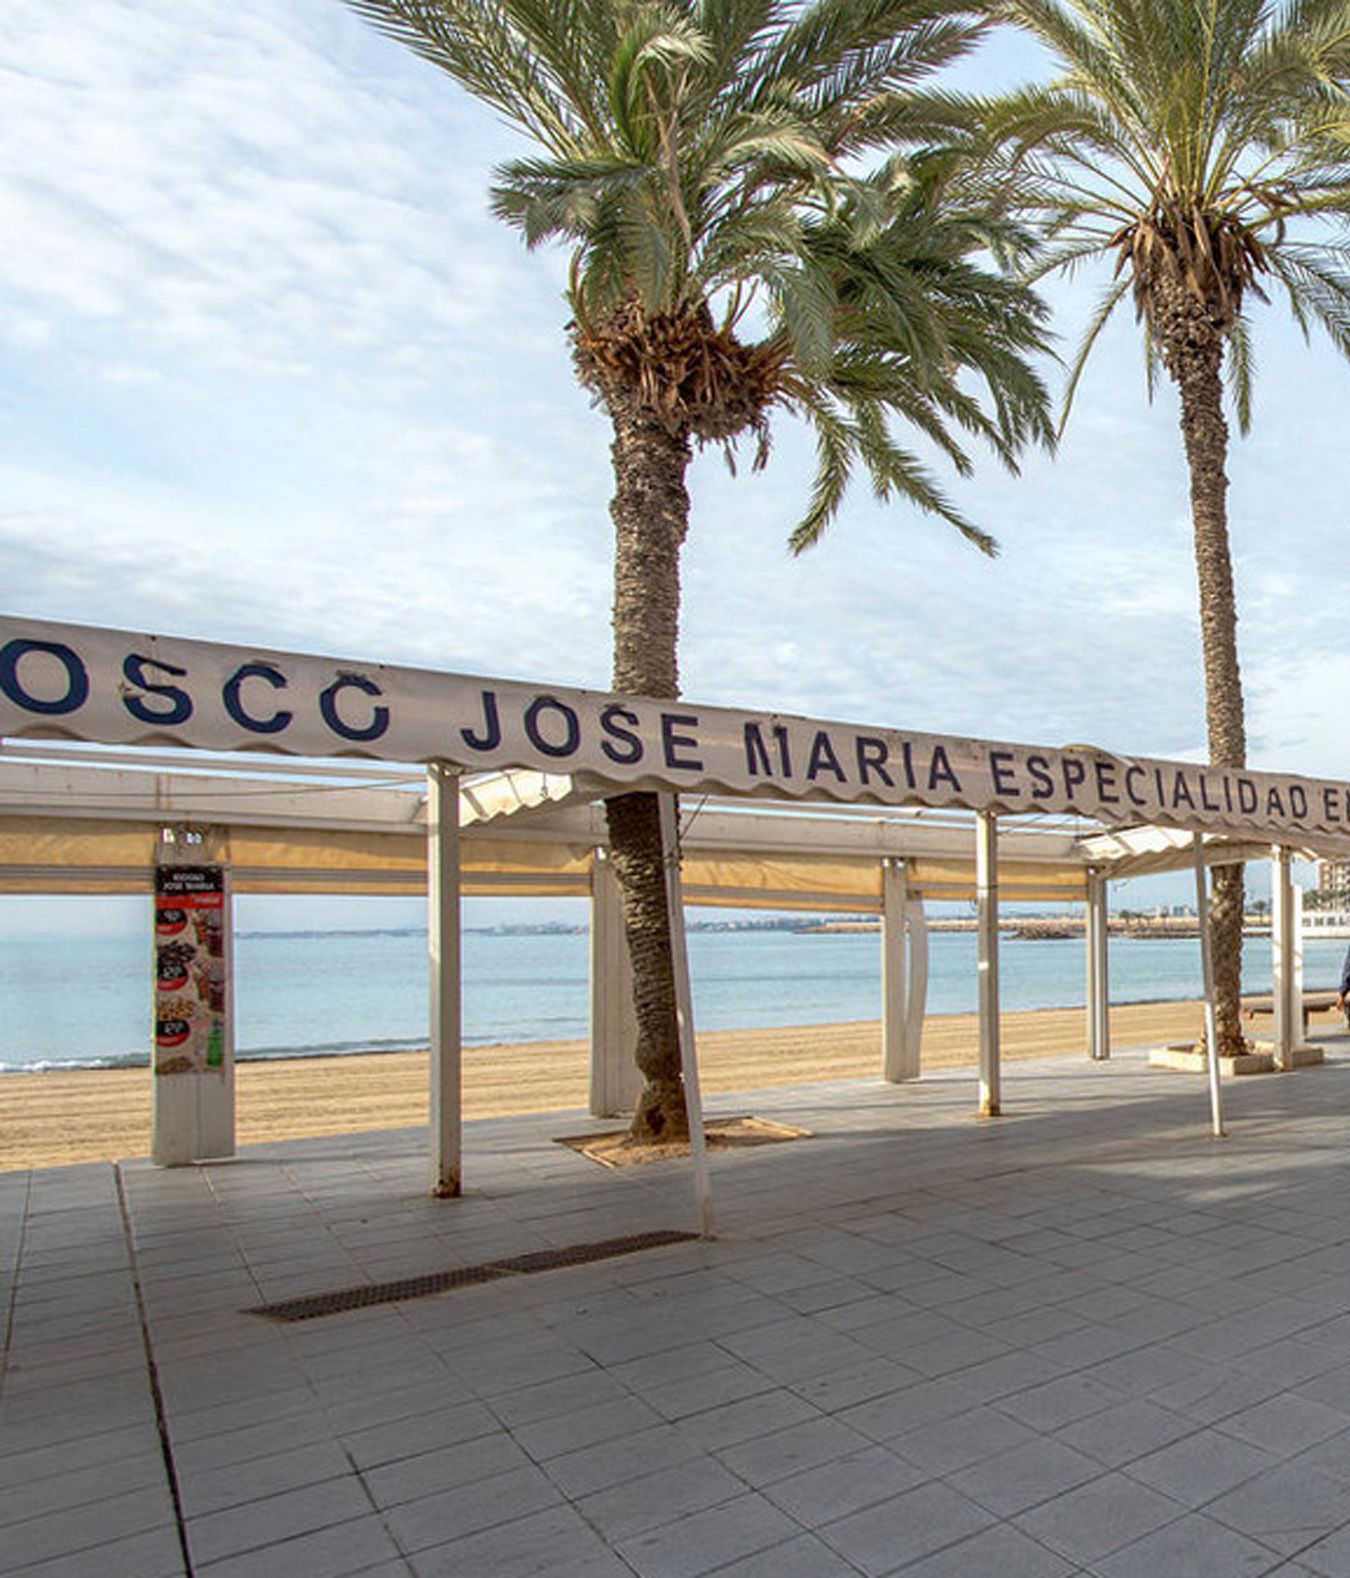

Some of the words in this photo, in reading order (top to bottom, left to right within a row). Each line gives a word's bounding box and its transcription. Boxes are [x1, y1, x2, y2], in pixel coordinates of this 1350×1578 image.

[461, 690, 704, 771] JOSE
[744, 721, 961, 793] MARIA
[990, 751, 1307, 820] ESPECIALIDAD
